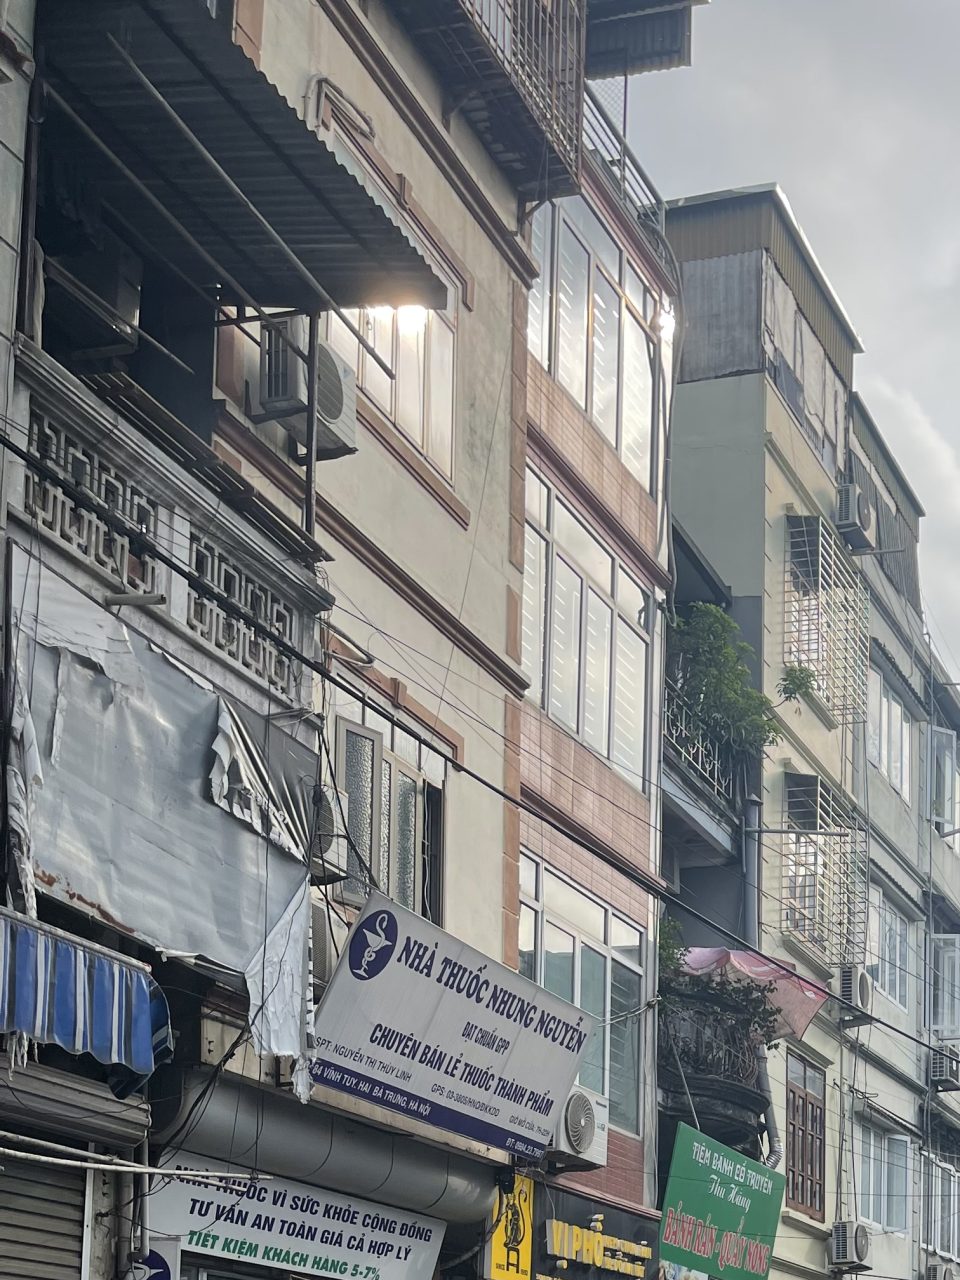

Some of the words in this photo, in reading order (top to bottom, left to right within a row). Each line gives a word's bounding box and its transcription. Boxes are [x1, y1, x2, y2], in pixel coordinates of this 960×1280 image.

[397, 935, 439, 978] NHÀ
[436, 956, 490, 1004] THUỐC
[486, 984, 537, 1029] NHUNG
[534, 1012, 588, 1055] NGUYỄN
[333, 1044, 363, 1063] NGUYỄN
[363, 1055, 377, 1070] THỊ
[377, 1060, 396, 1077] THÙY
[395, 1068, 412, 1083] LINH
[461, 1021, 476, 1043] ĐẠT
[474, 1026, 498, 1050] CHUẨN
[496, 1037, 511, 1056] GPP
[323, 1066, 342, 1083] VĨNH
[357, 1080, 372, 1094] HAI
[372, 1085, 384, 1098] BÀ
[408, 1100, 419, 1111] HÀ
[418, 1104, 431, 1117] NỘI
[369, 1023, 422, 1061] CHUYÊN
[418, 1044, 447, 1072] BÁN
[443, 1053, 463, 1078] LẺ
[459, 1062, 495, 1092] THUỐC
[493, 1077, 528, 1105] THÀNH
[524, 1090, 555, 1117] PHẨM
[692, 1141, 711, 1166] TIỆM
[712, 1151, 734, 1176] BÁNH
[734, 1160, 747, 1183] CỔ
[747, 1168, 773, 1196] TRUYỀN
[708, 1173, 726, 1199] Thu
[727, 1183, 752, 1213] Hằng
[188, 1198, 215, 1217] TƯ
[215, 1203, 249, 1227] VẤN
[250, 1213, 274, 1233] AN
[278, 1219, 316, 1242] TOÀN
[319, 1228, 343, 1249] GIÁ
[346, 1232, 366, 1252] CẢ
[367, 1240, 393, 1262] HỢP
[395, 1244, 411, 1262] LÝ
[272, 1187, 288, 1208] VÌ
[290, 1193, 319, 1215] SỨC
[323, 1203, 359, 1226] KHỎE
[362, 1213, 397, 1237] CỘNG
[399, 1221, 433, 1243] ĐỒNG
[662, 1200, 694, 1255] BÁNH
[692, 1213, 718, 1259] RÁN
[718, 1215, 747, 1272] QUẨY
[744, 1233, 772, 1277] NÓNG
[187, 1227, 219, 1250] TIẾT
[221, 1237, 259, 1259] KIỆM
[262, 1245, 308, 1268] KHÁCH
[311, 1254, 348, 1275] HÀNG
